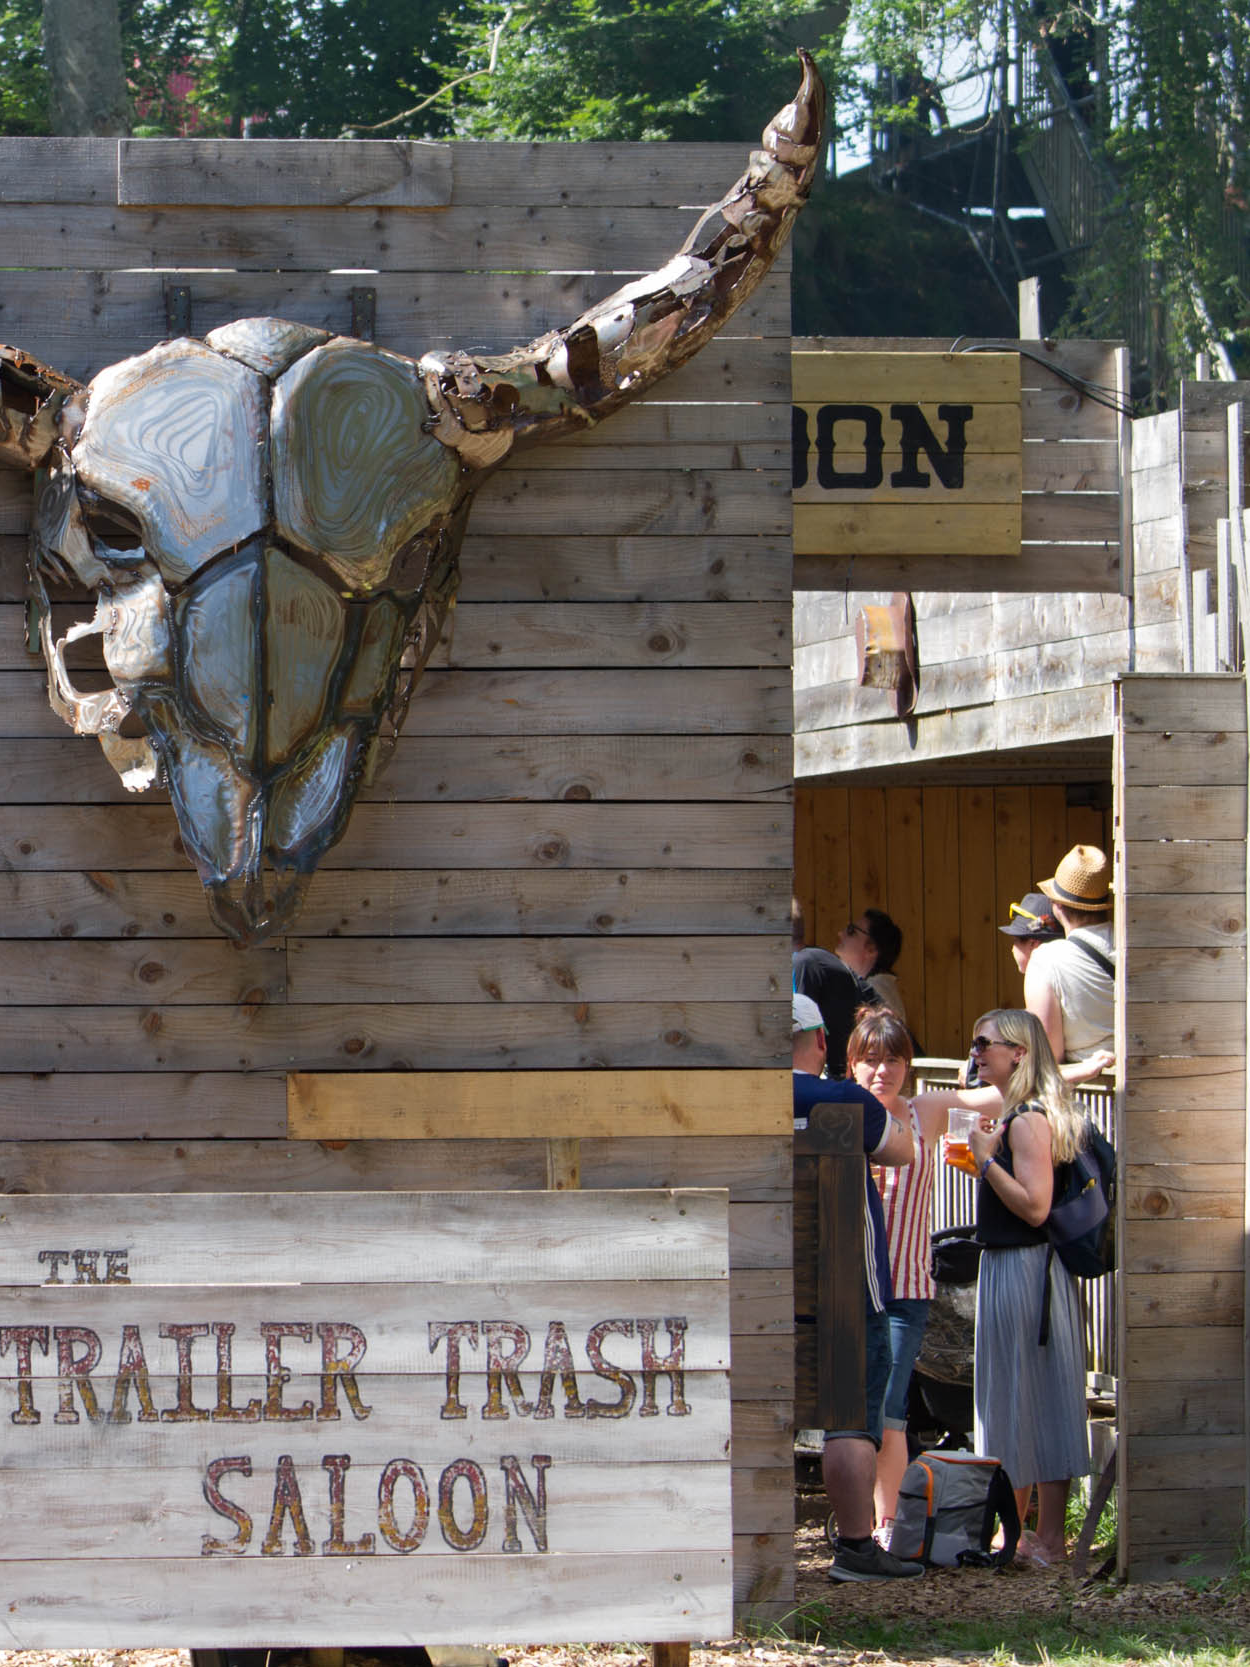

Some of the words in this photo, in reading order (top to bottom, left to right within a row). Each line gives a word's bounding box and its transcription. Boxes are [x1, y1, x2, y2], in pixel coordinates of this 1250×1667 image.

[792, 404, 974, 489] ON
[38, 1249, 132, 1285] THE
[427, 1316, 692, 1420] TRASH
[201, 1454, 553, 1557] SALOON
